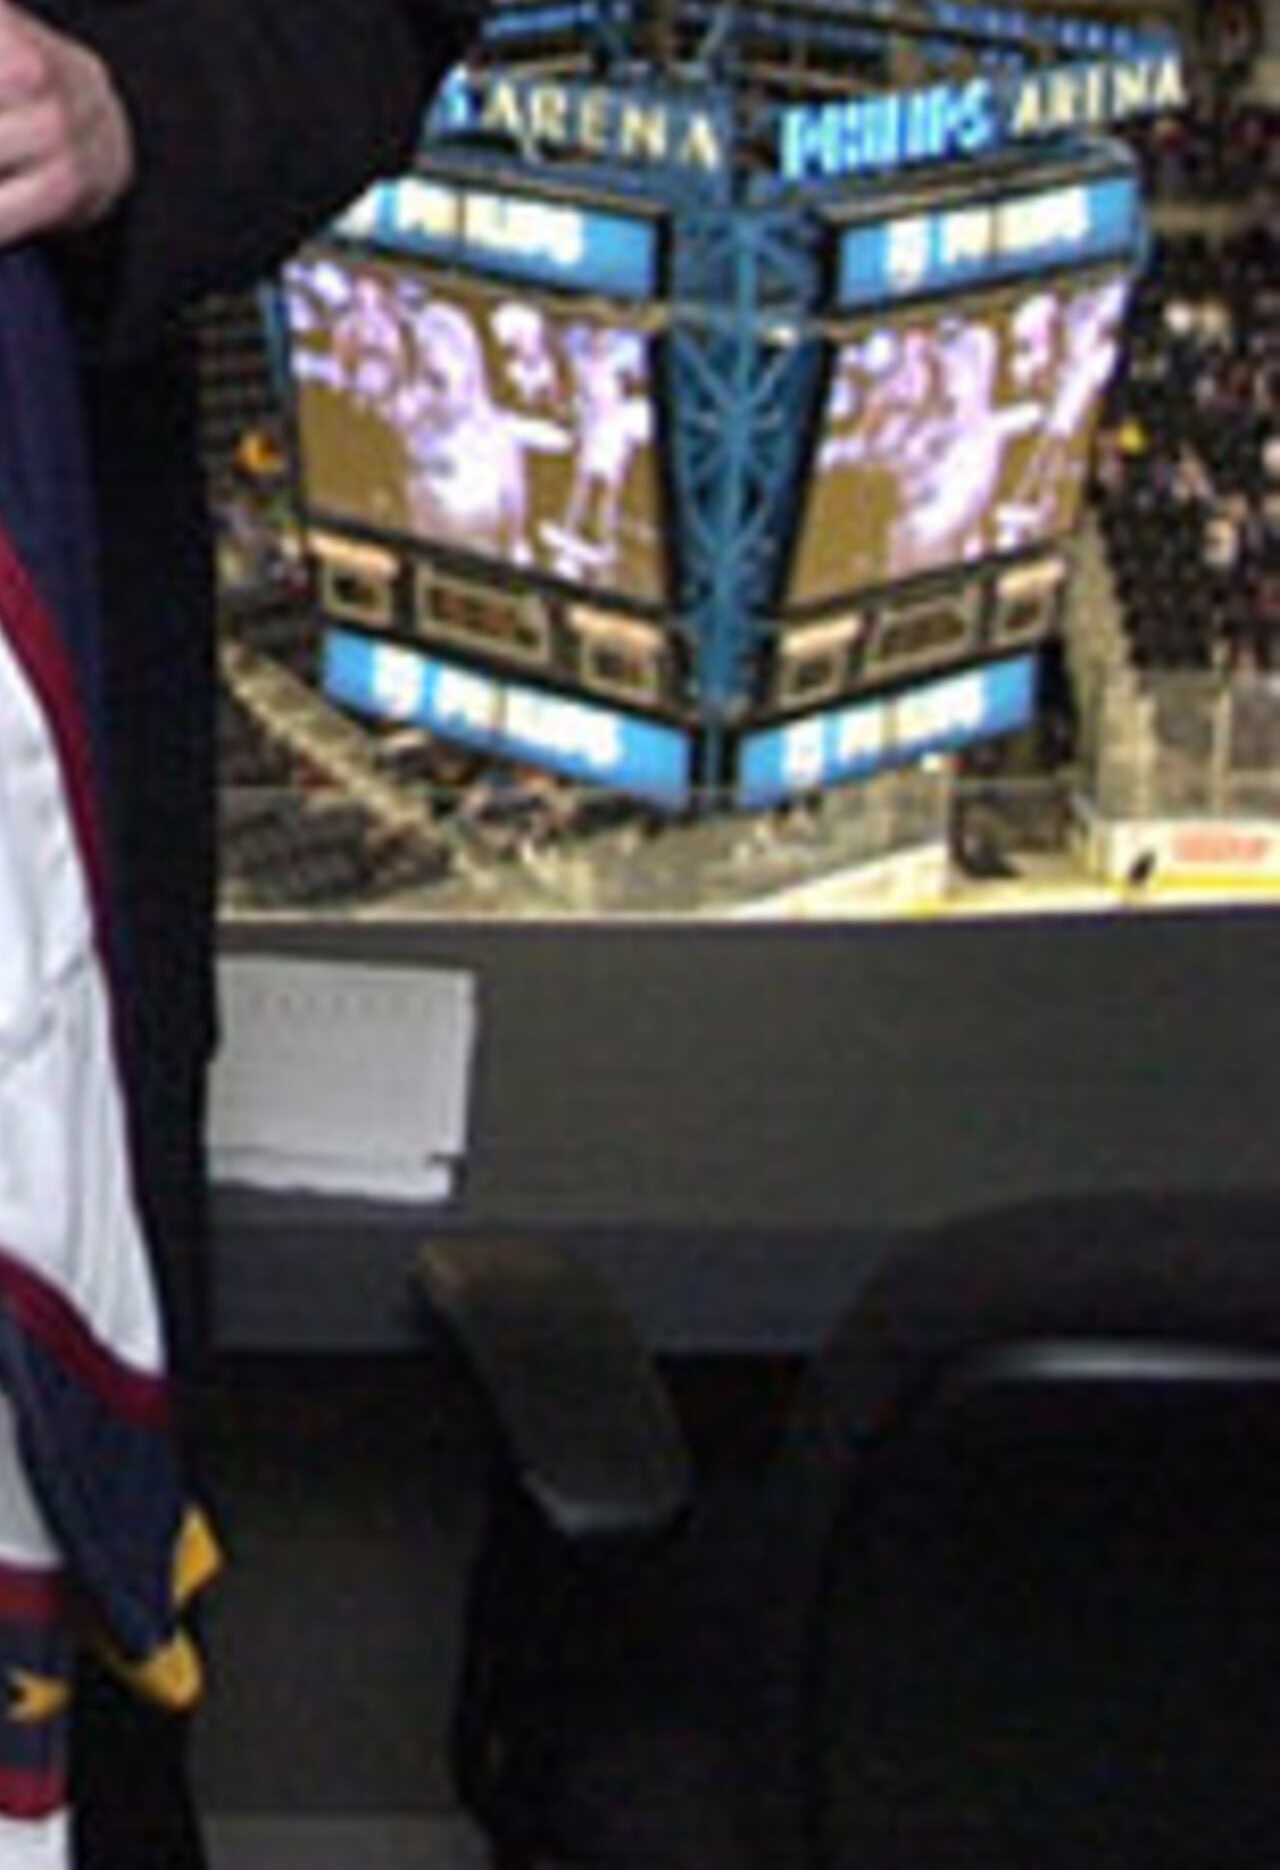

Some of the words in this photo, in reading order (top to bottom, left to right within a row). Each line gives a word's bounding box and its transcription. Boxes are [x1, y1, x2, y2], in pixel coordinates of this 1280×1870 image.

[482, 77, 722, 170] ARENA
[780, 75, 993, 180] PHILIPS
[1012, 51, 1187, 132] ARENA
